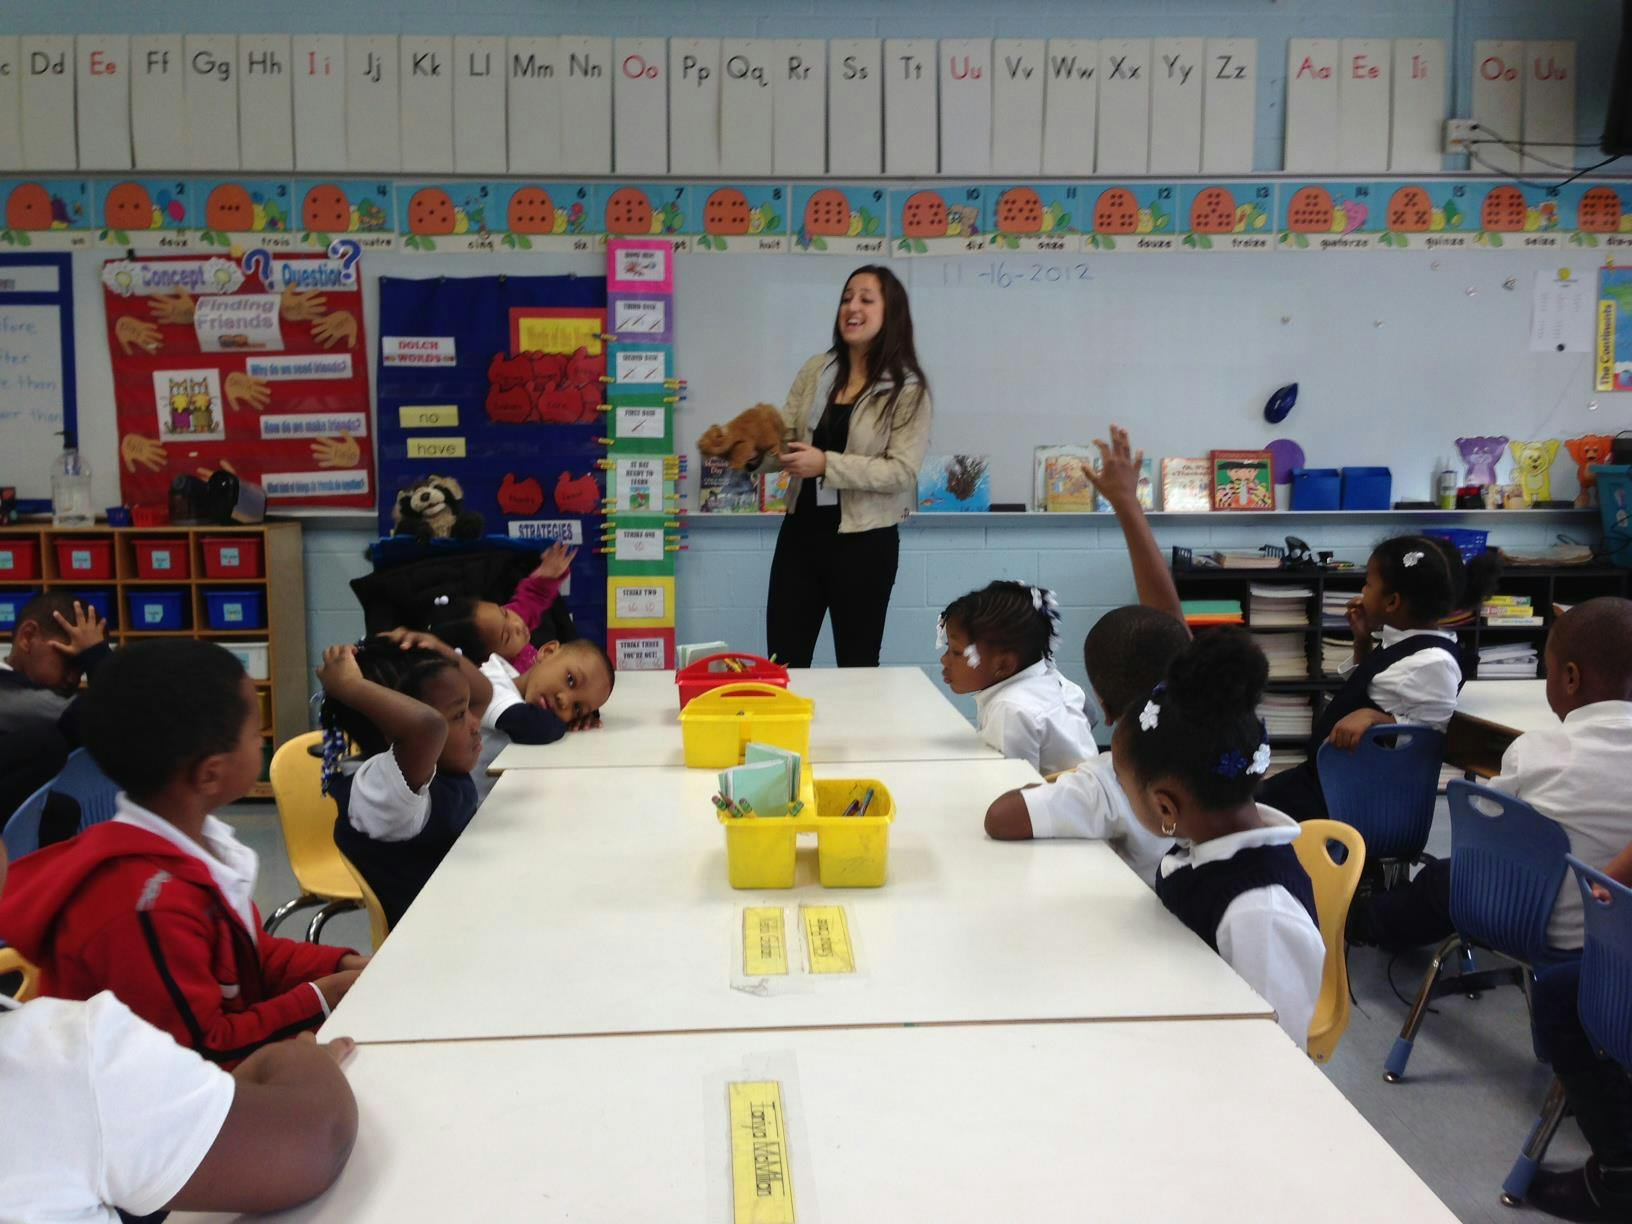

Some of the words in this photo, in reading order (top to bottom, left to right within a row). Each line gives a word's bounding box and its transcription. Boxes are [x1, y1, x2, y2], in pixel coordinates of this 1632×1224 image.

[31, 52, 64, 75] Dd
[90, 51, 116, 75] Ee
[147, 51, 168, 73] Ff
[192, 51, 230, 81] Gg
[249, 52, 281, 74] Hh
[309, 52, 329, 75] Ii
[364, 53, 381, 83] Jj
[413, 53, 440, 75] Kk
[470, 53, 490, 76] Ll
[514, 54, 553, 77] Mm
[570, 53, 601, 77] Nn
[623, 55, 658, 79] Oo
[684, 56, 710, 86] Pp
[727, 56, 768, 87] Qq
[789, 57, 810, 79] Rr
[844, 56, 867, 79] Ss
[900, 56, 921, 79] Tt
[951, 57, 981, 80] Uu
[1006, 57, 1033, 79] Vv
[1052, 57, 1094, 79] Ww
[1109, 56, 1139, 79] Xx
[1164, 55, 1193, 85] Yy
[1216, 56, 1245, 79] Zz
[1297, 57, 1331, 79] Aa
[1353, 55, 1379, 79] Ee
[1412, 55, 1426, 79] Ii
[177, 183, 184, 195] 2
[278, 184, 286, 196] 3
[377, 185, 387, 196] 4
[480, 187, 489, 198] 5
[577, 188, 586, 199] 6
[675, 188, 684, 199] 7
[773, 188, 781, 199] 8
[873, 191, 883, 201] 9
[967, 189, 980, 200] 10
[1158, 189, 1171, 199] 12
[357, 236, 392, 246] uatre
[672, 240, 687, 253] pt
[140, 266, 206, 290] Concept
[199, 300, 274, 314] Finding
[198, 314, 273, 330] Friends
[399, 341, 438, 350] DOLCH
[397, 353, 442, 363] WORDS
[419, 412, 440, 424] no
[416, 443, 457, 455] have
[519, 524, 573, 541] STRATEGIES
